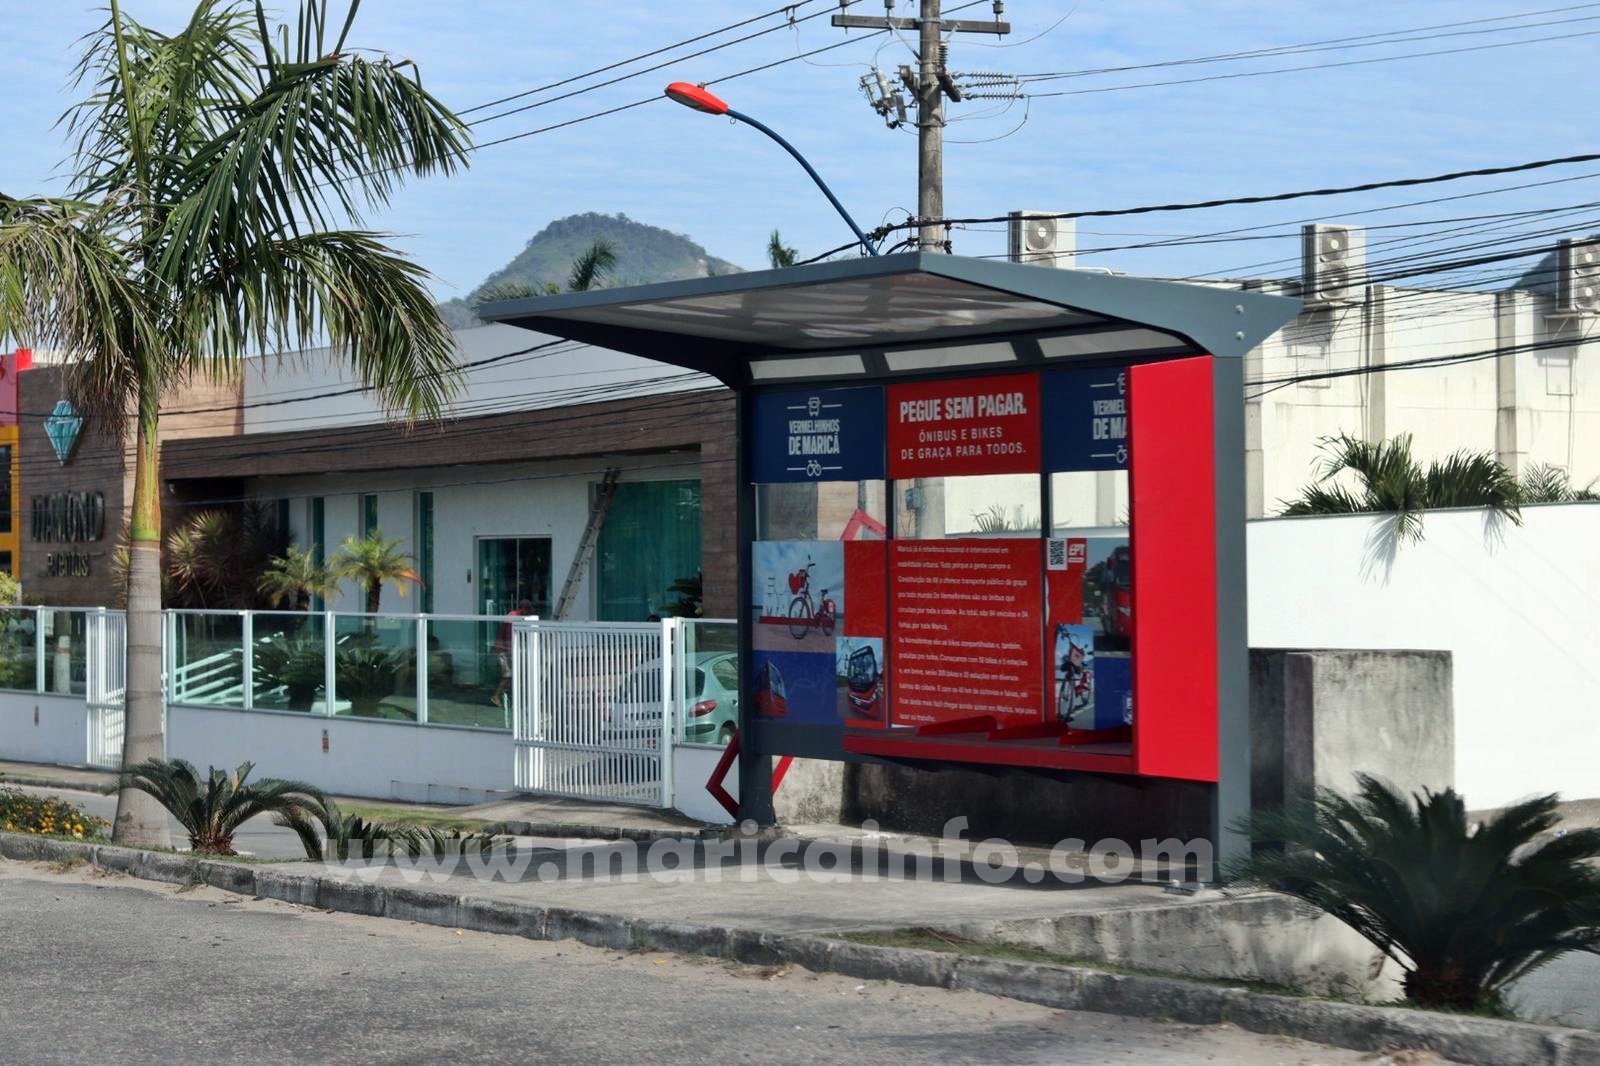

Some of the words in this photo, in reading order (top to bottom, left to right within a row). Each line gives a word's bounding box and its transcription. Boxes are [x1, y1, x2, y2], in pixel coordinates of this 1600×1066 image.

[900, 399, 941, 423] PEGUE
[945, 396, 974, 420] SEM
[977, 392, 1027, 417] PAGAR.
[1093, 398, 1126, 415] VERMEL
[789, 419, 840, 434] VERMELHINHOS
[919, 429, 957, 442] ÔNIBUS
[961, 429, 967, 440] E
[971, 426, 1003, 440] BIKES
[1093, 418, 1109, 440] DE
[789, 436, 801, 455] DE
[802, 432, 840, 455] MARICÁ
[901, 448, 914, 460] DE
[918, 446, 952, 460] GRAÇA
[956, 445, 982, 457] PARA
[986, 441, 1027, 455] TODOS.
